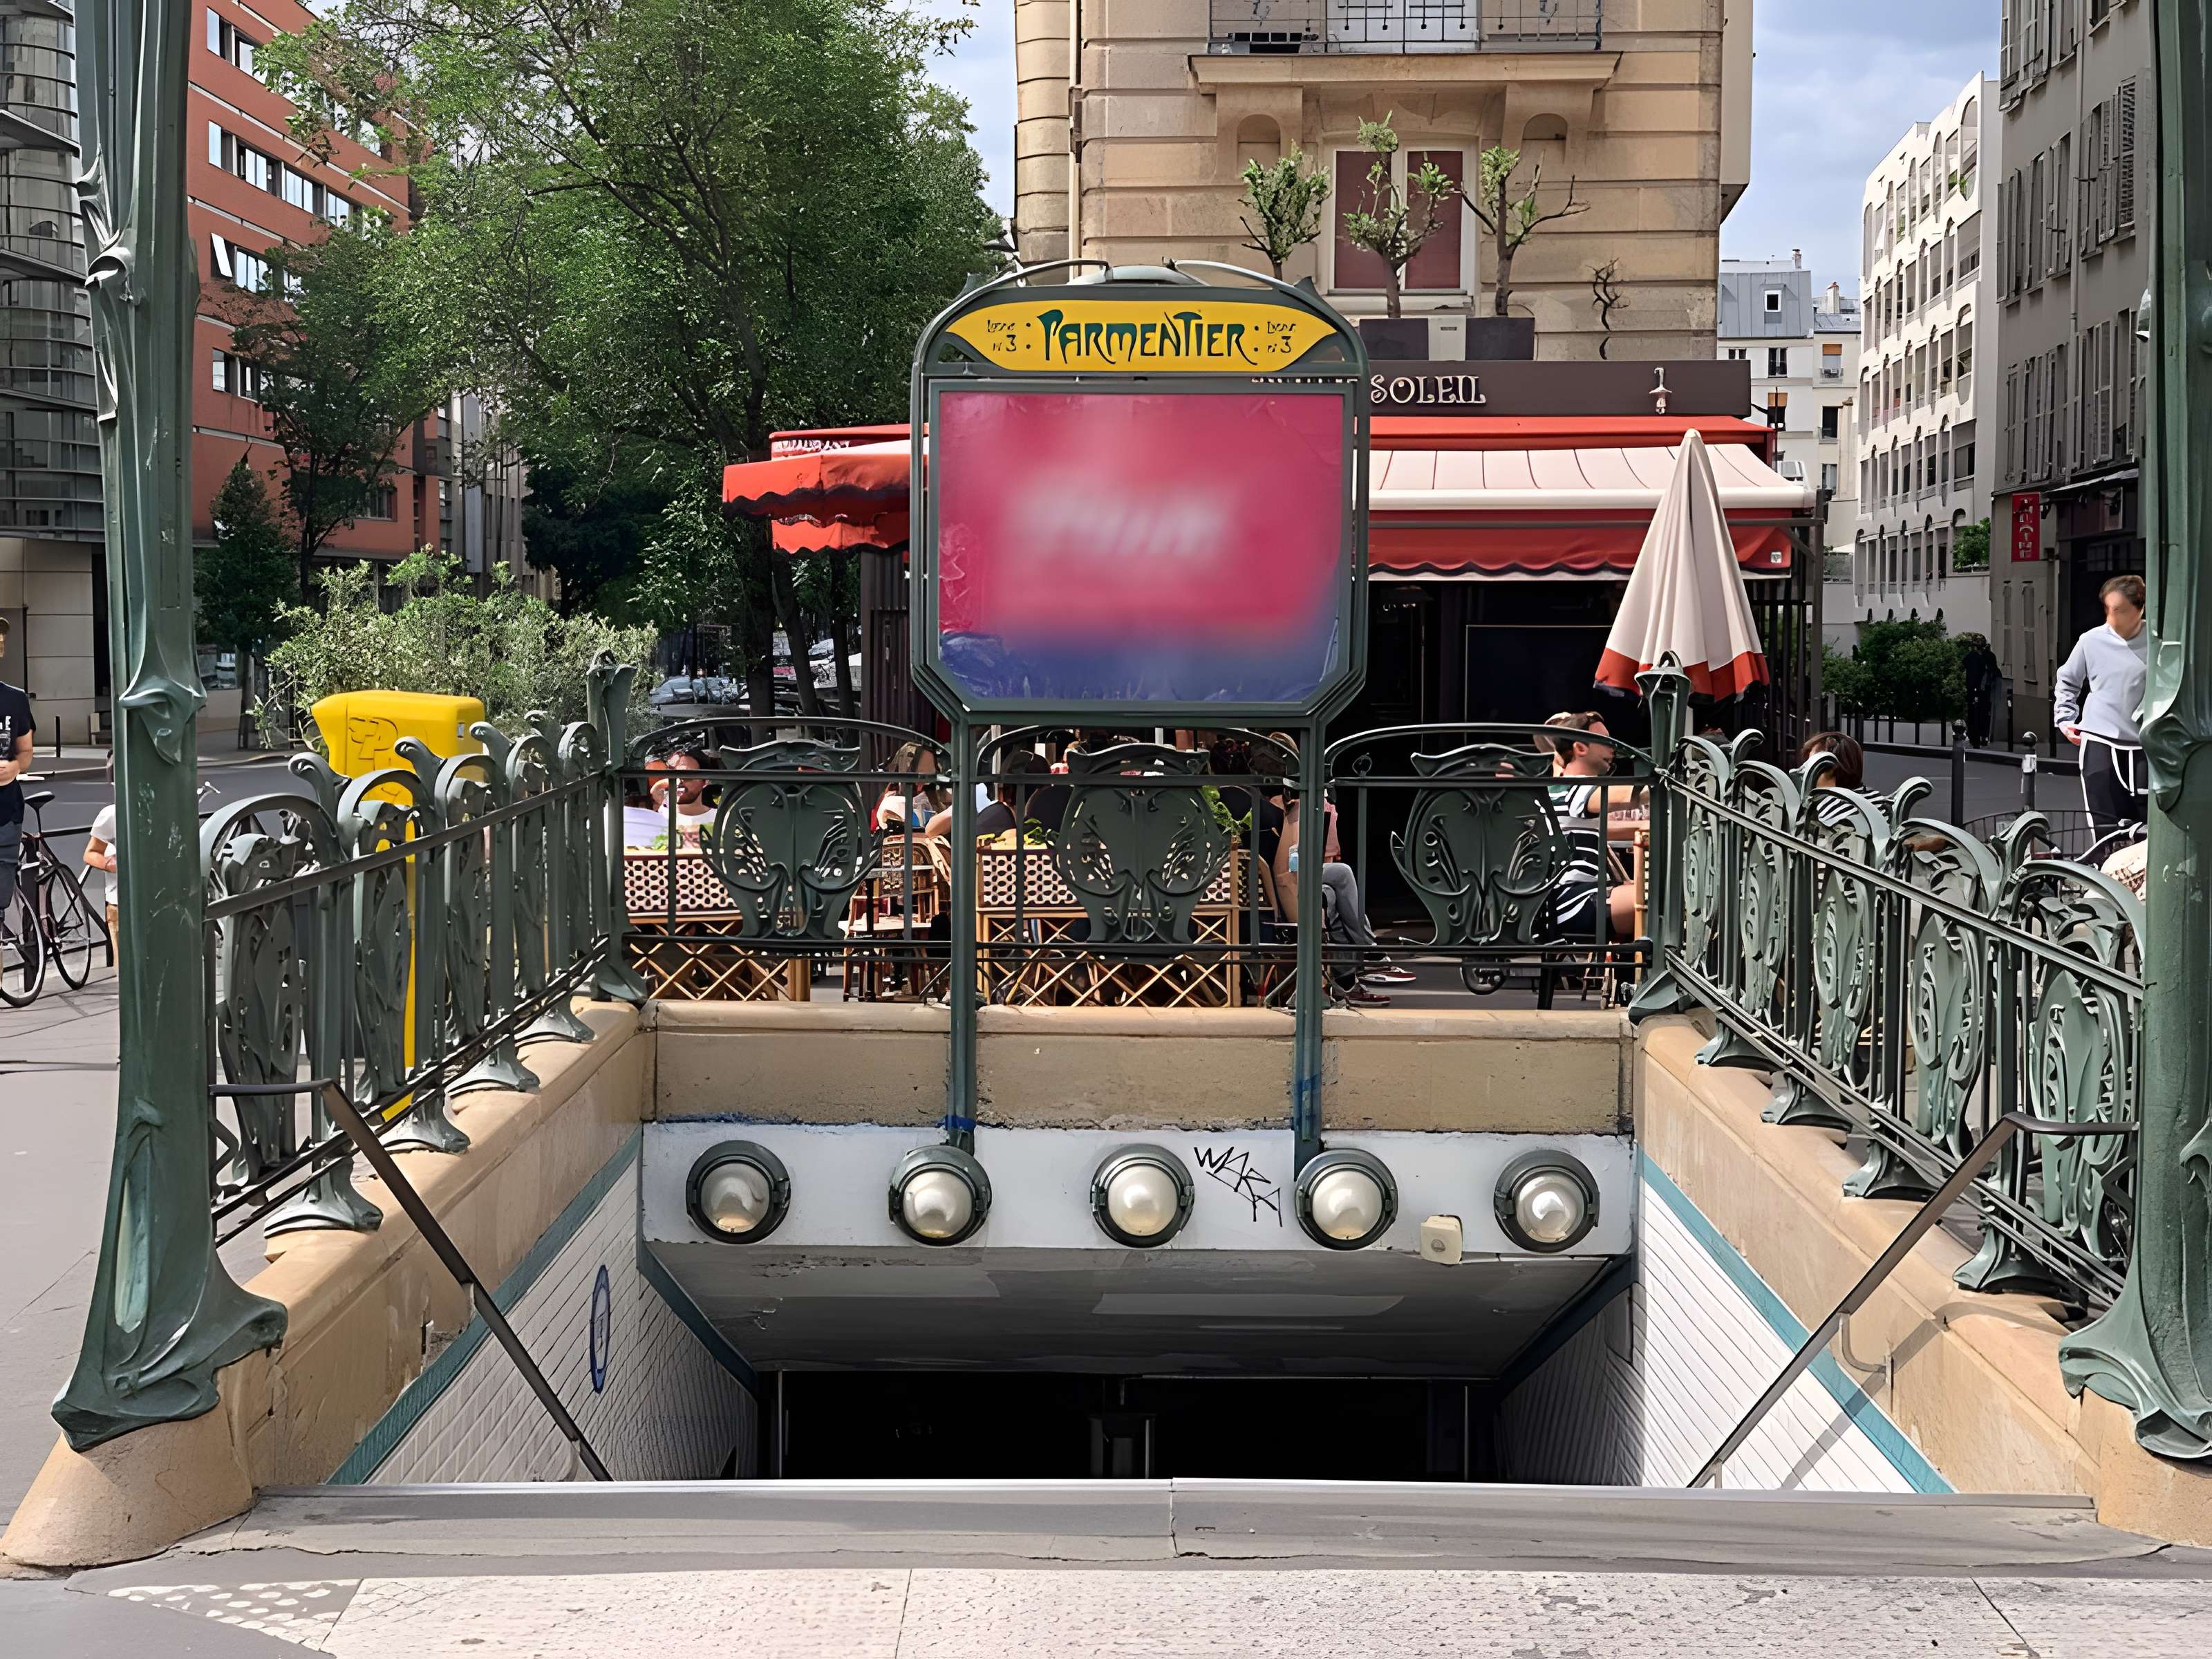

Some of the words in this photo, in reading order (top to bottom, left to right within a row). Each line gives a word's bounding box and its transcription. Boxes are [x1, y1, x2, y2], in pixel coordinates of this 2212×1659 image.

[1006, 334, 1017, 352] 3
[1036, 309, 1258, 366] PARMENTIER
[1280, 335, 1292, 353] 3
[1370, 374, 1487, 404] SOLEIL
